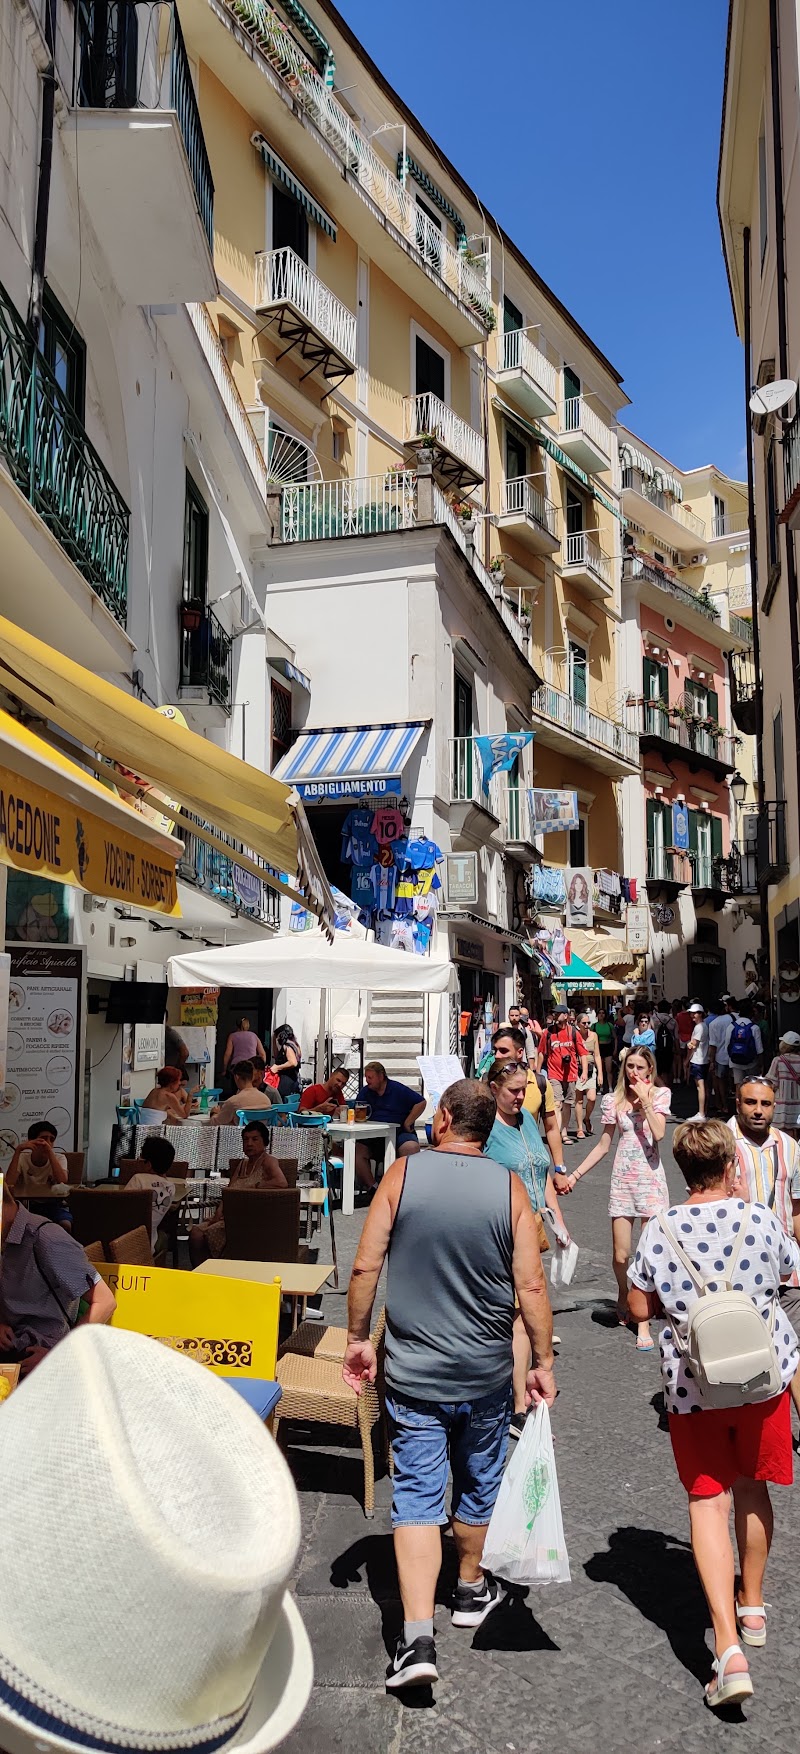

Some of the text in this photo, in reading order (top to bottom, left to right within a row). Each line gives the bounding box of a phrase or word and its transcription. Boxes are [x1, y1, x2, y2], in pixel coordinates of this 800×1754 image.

[304, 780, 387, 796] ABBIGLIAMENTO
[379, 822, 397, 838] 10
[104, 840, 135, 893] YOGURT
[40, 955, 78, 969] Apicella
